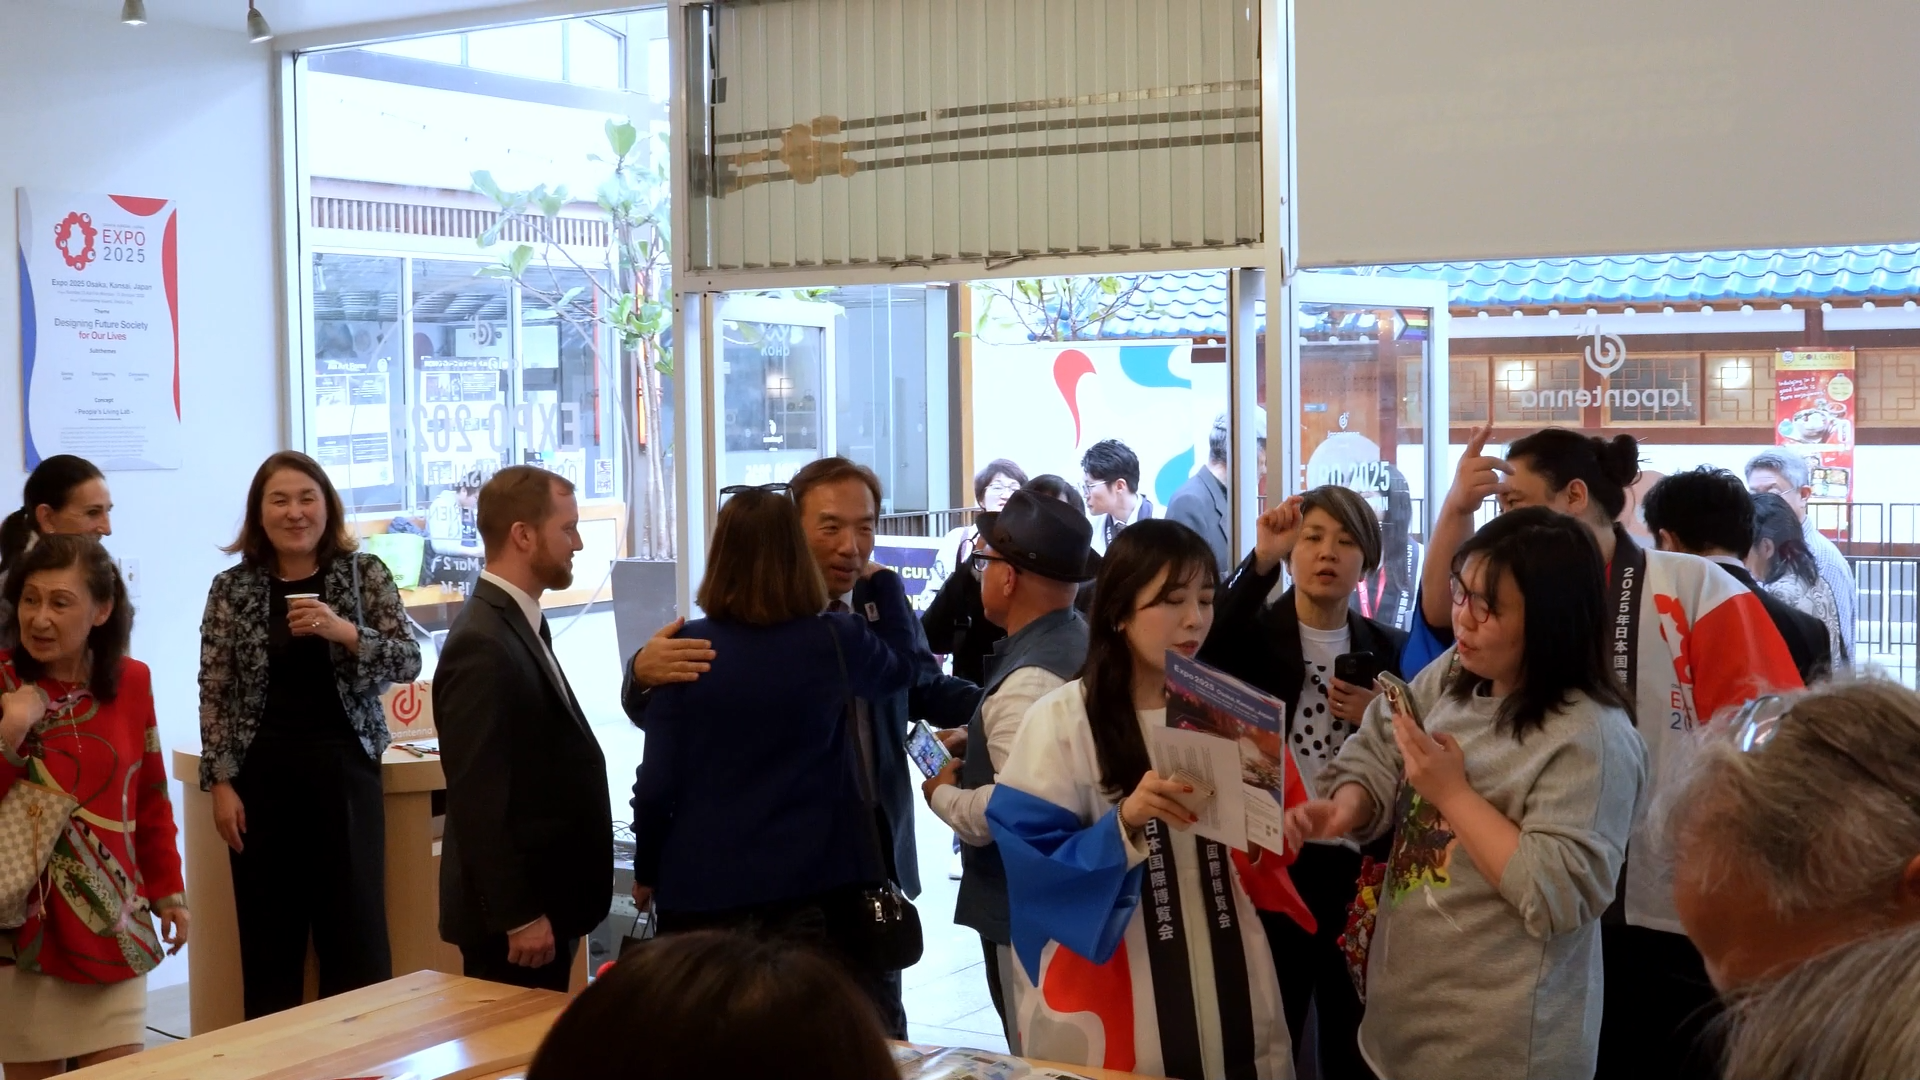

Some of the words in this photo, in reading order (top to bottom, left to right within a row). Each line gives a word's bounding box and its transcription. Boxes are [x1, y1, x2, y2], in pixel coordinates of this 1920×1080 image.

[102, 229, 146, 246] EXPO
[103, 246, 146, 262] 2025
[54, 318, 93, 329] Designing
[94, 320, 119, 329] Future
[120, 320, 148, 331] Society
[79, 331, 90, 339] for
[91, 332, 106, 340] Our
[107, 332, 127, 340] Lives
[1349, 461, 1390, 492] 2025
[902, 566, 931, 580] CUL
[391, 728, 433, 738] pantenna
[1206, 842, 1232, 929] 国際博覧会
